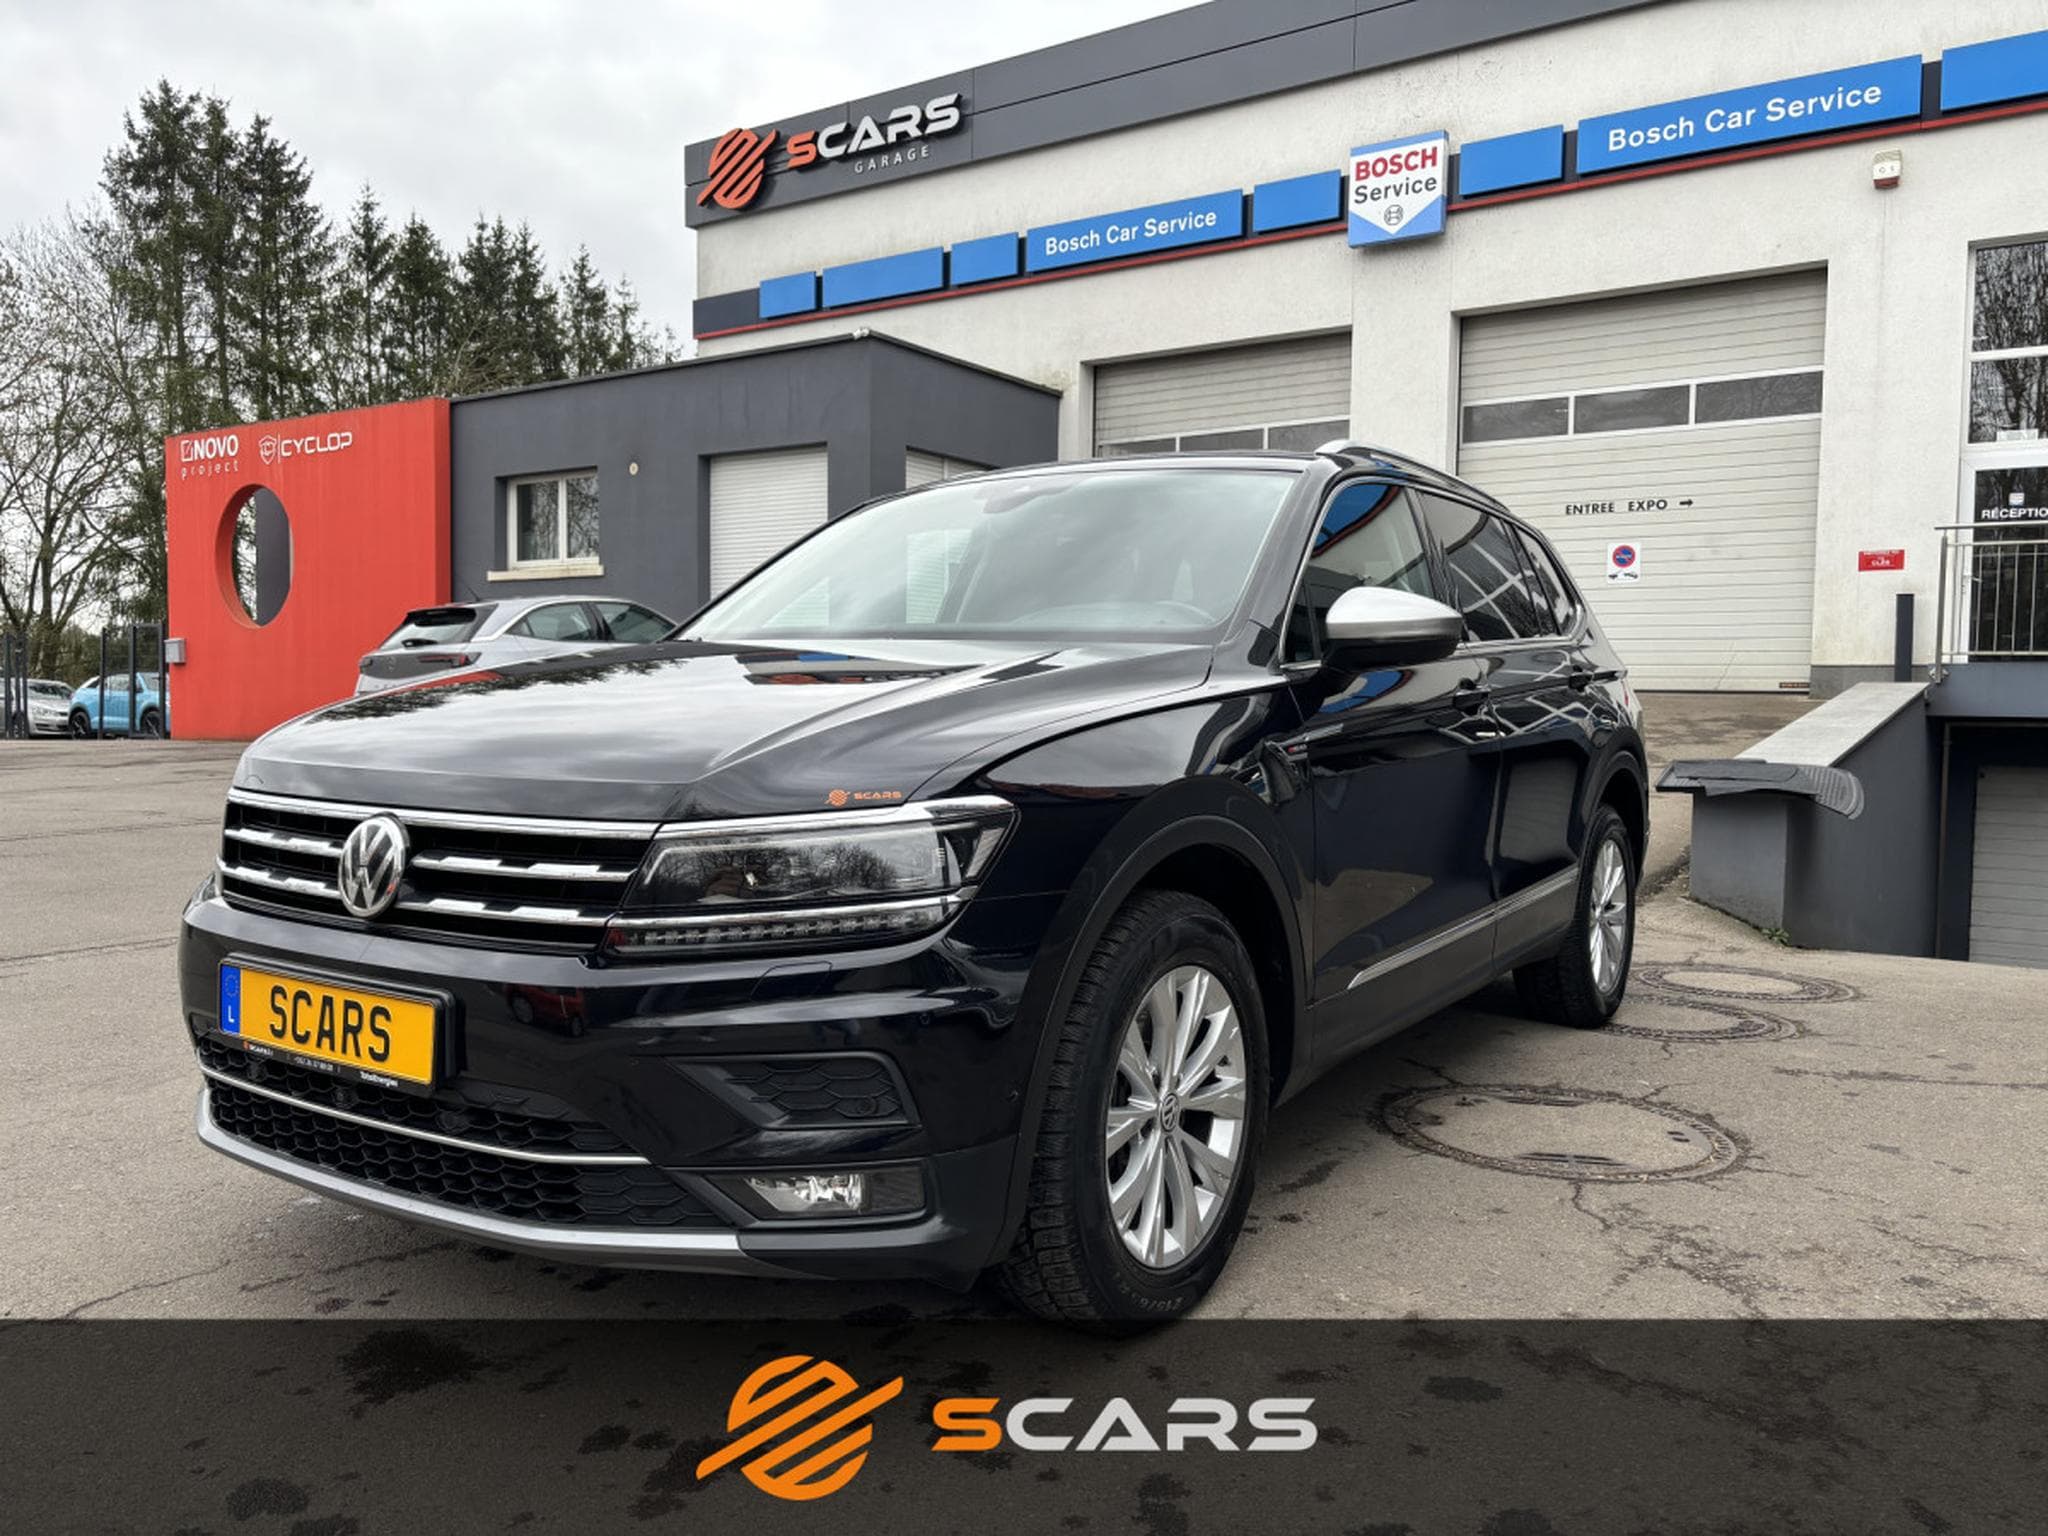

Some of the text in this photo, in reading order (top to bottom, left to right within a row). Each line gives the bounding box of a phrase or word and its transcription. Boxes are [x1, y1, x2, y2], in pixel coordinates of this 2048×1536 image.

[786, 93, 960, 168] SCARS
[1608, 86, 1881, 151] Bosch Car Service
[854, 145, 930, 173] GARAGE
[1355, 146, 1438, 182] BOSCH
[1354, 177, 1437, 204] Service
[1045, 211, 1217, 256] Bosch Car Service
[181, 460, 239, 481] project
[1565, 499, 1668, 515] ENTREE EXPO
[227, 1005, 236, 1023] L
[269, 985, 392, 1062] SCARS
